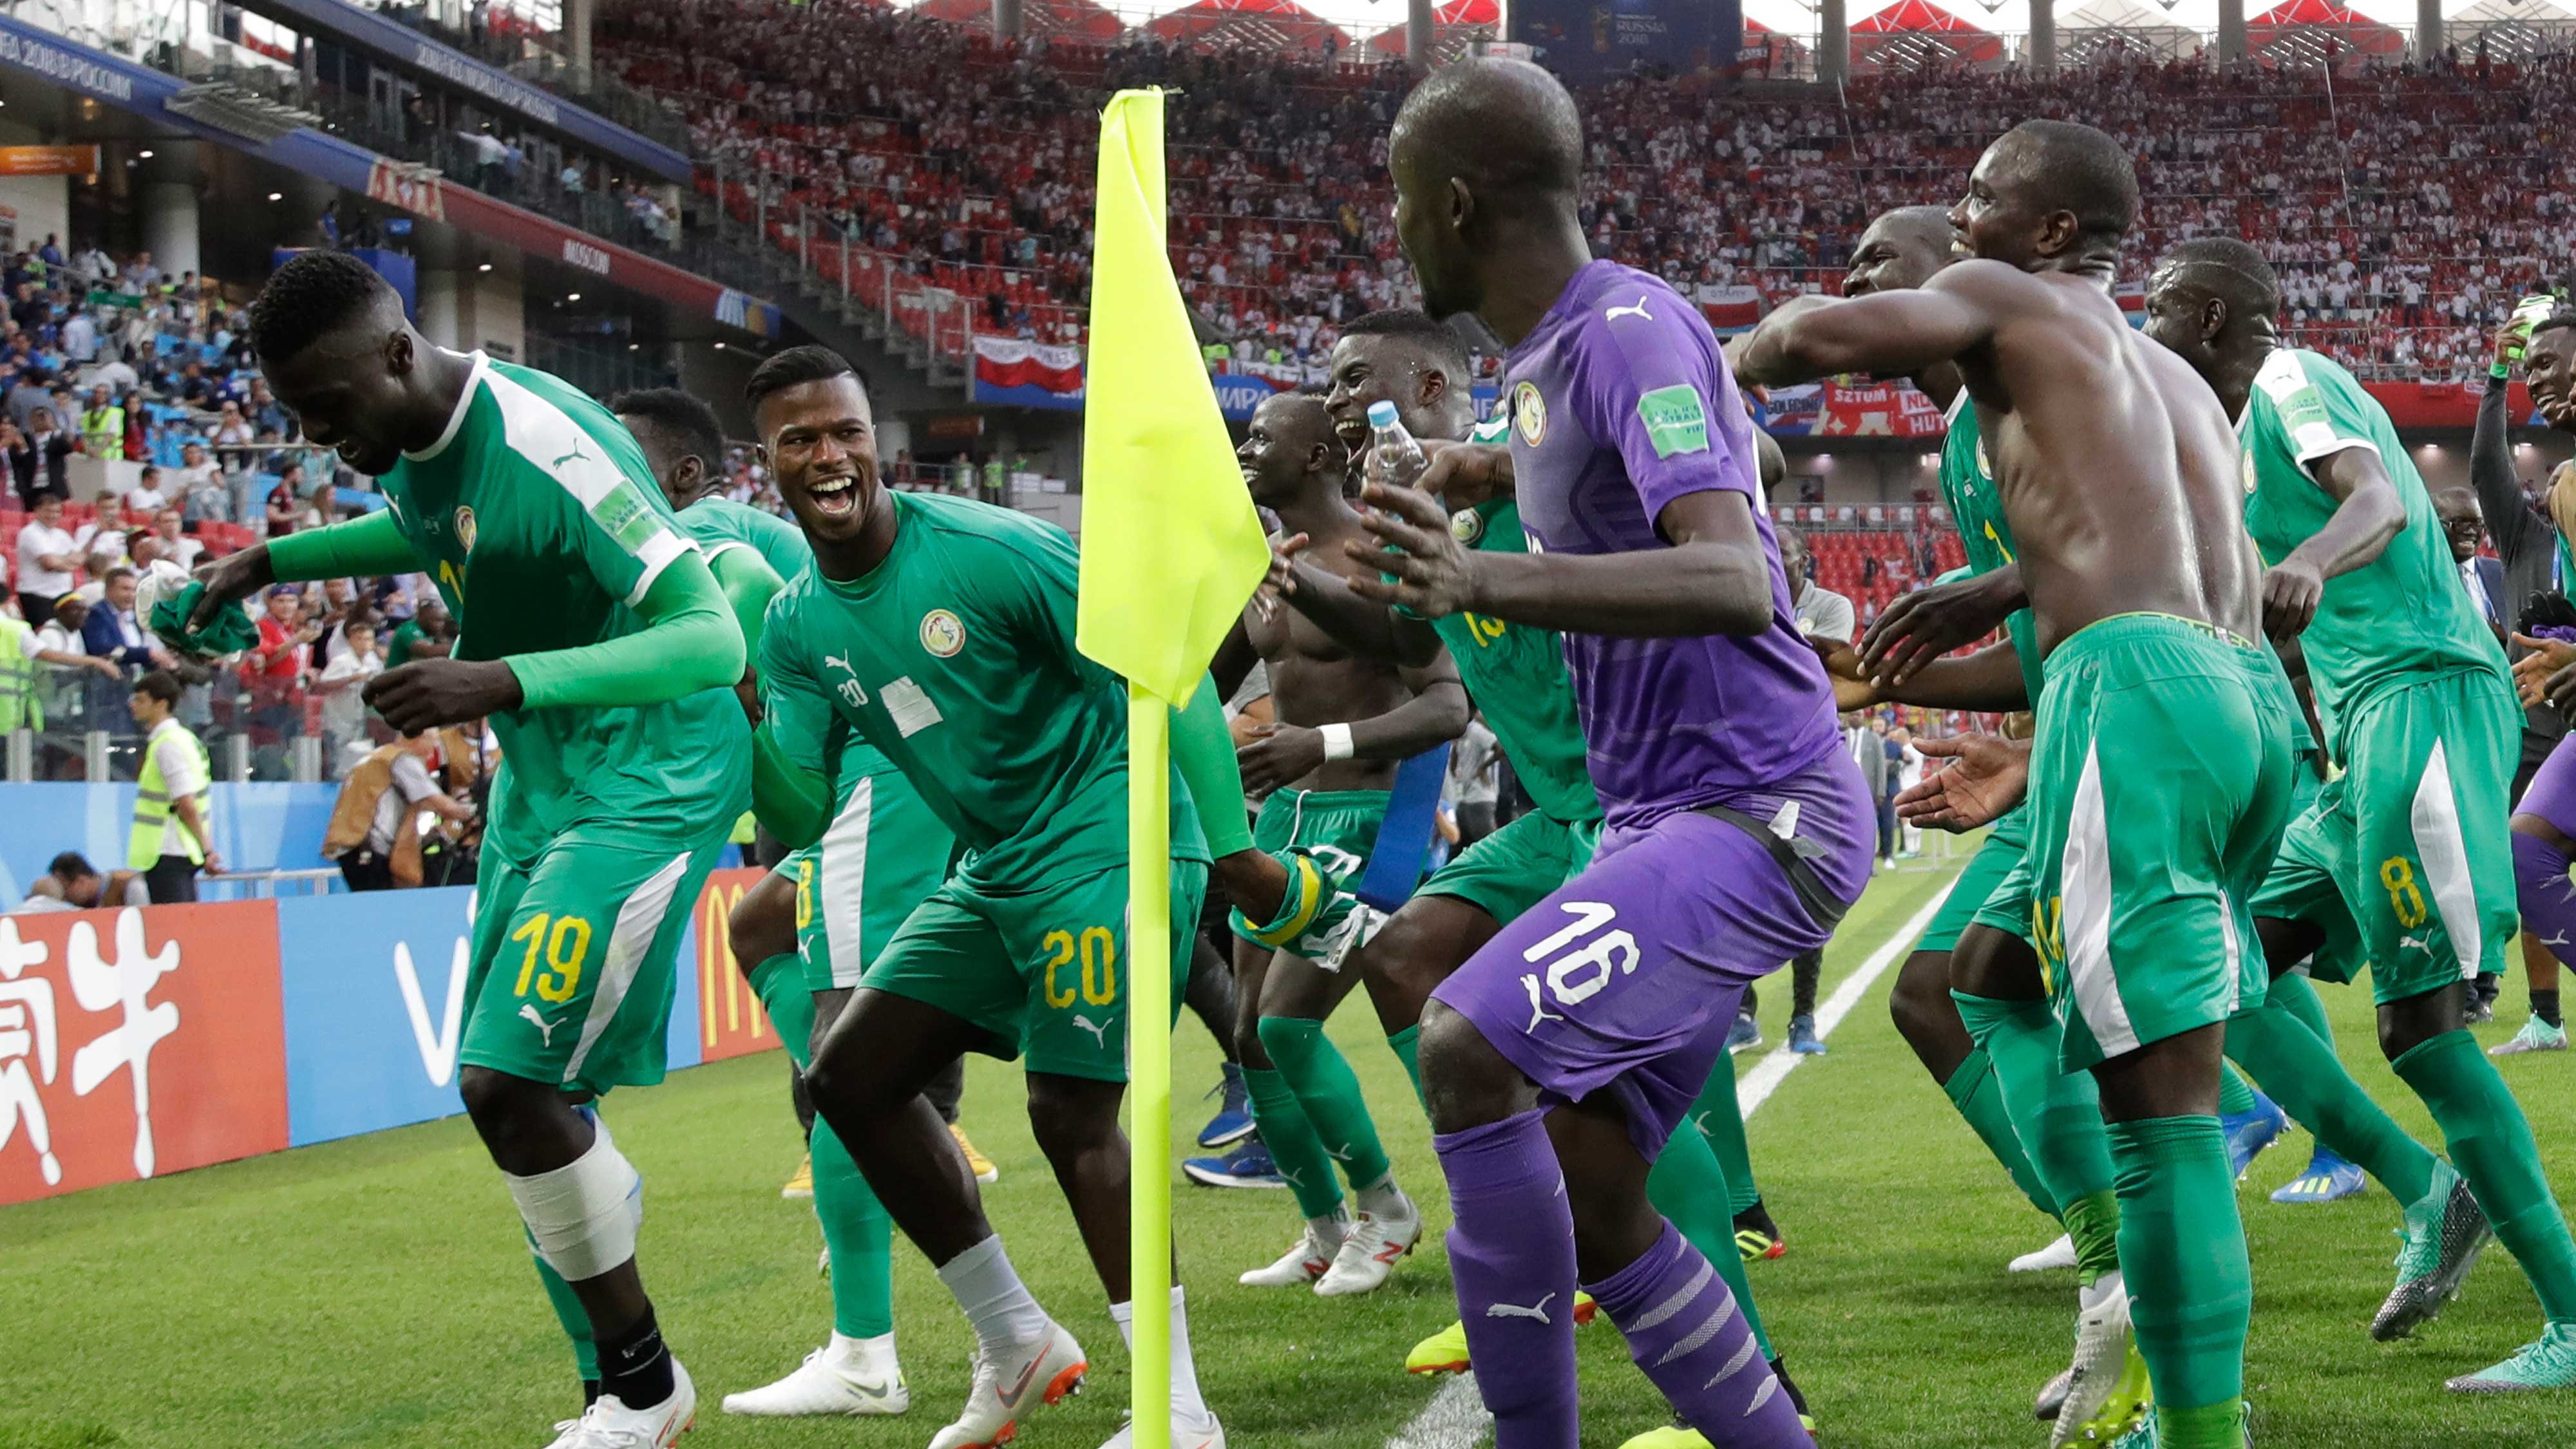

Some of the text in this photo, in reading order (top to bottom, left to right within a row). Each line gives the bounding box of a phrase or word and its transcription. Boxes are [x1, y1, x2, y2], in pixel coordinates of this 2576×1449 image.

[1616, 21, 1667, 32] RUSSIA
[1834, 388, 1887, 403] SZTUM
[837, 678, 869, 707] 20
[2380, 856, 2427, 928] 8
[512, 912, 591, 1003] 19
[1043, 926, 1115, 1009] 20
[1522, 902, 1641, 1005] 16
